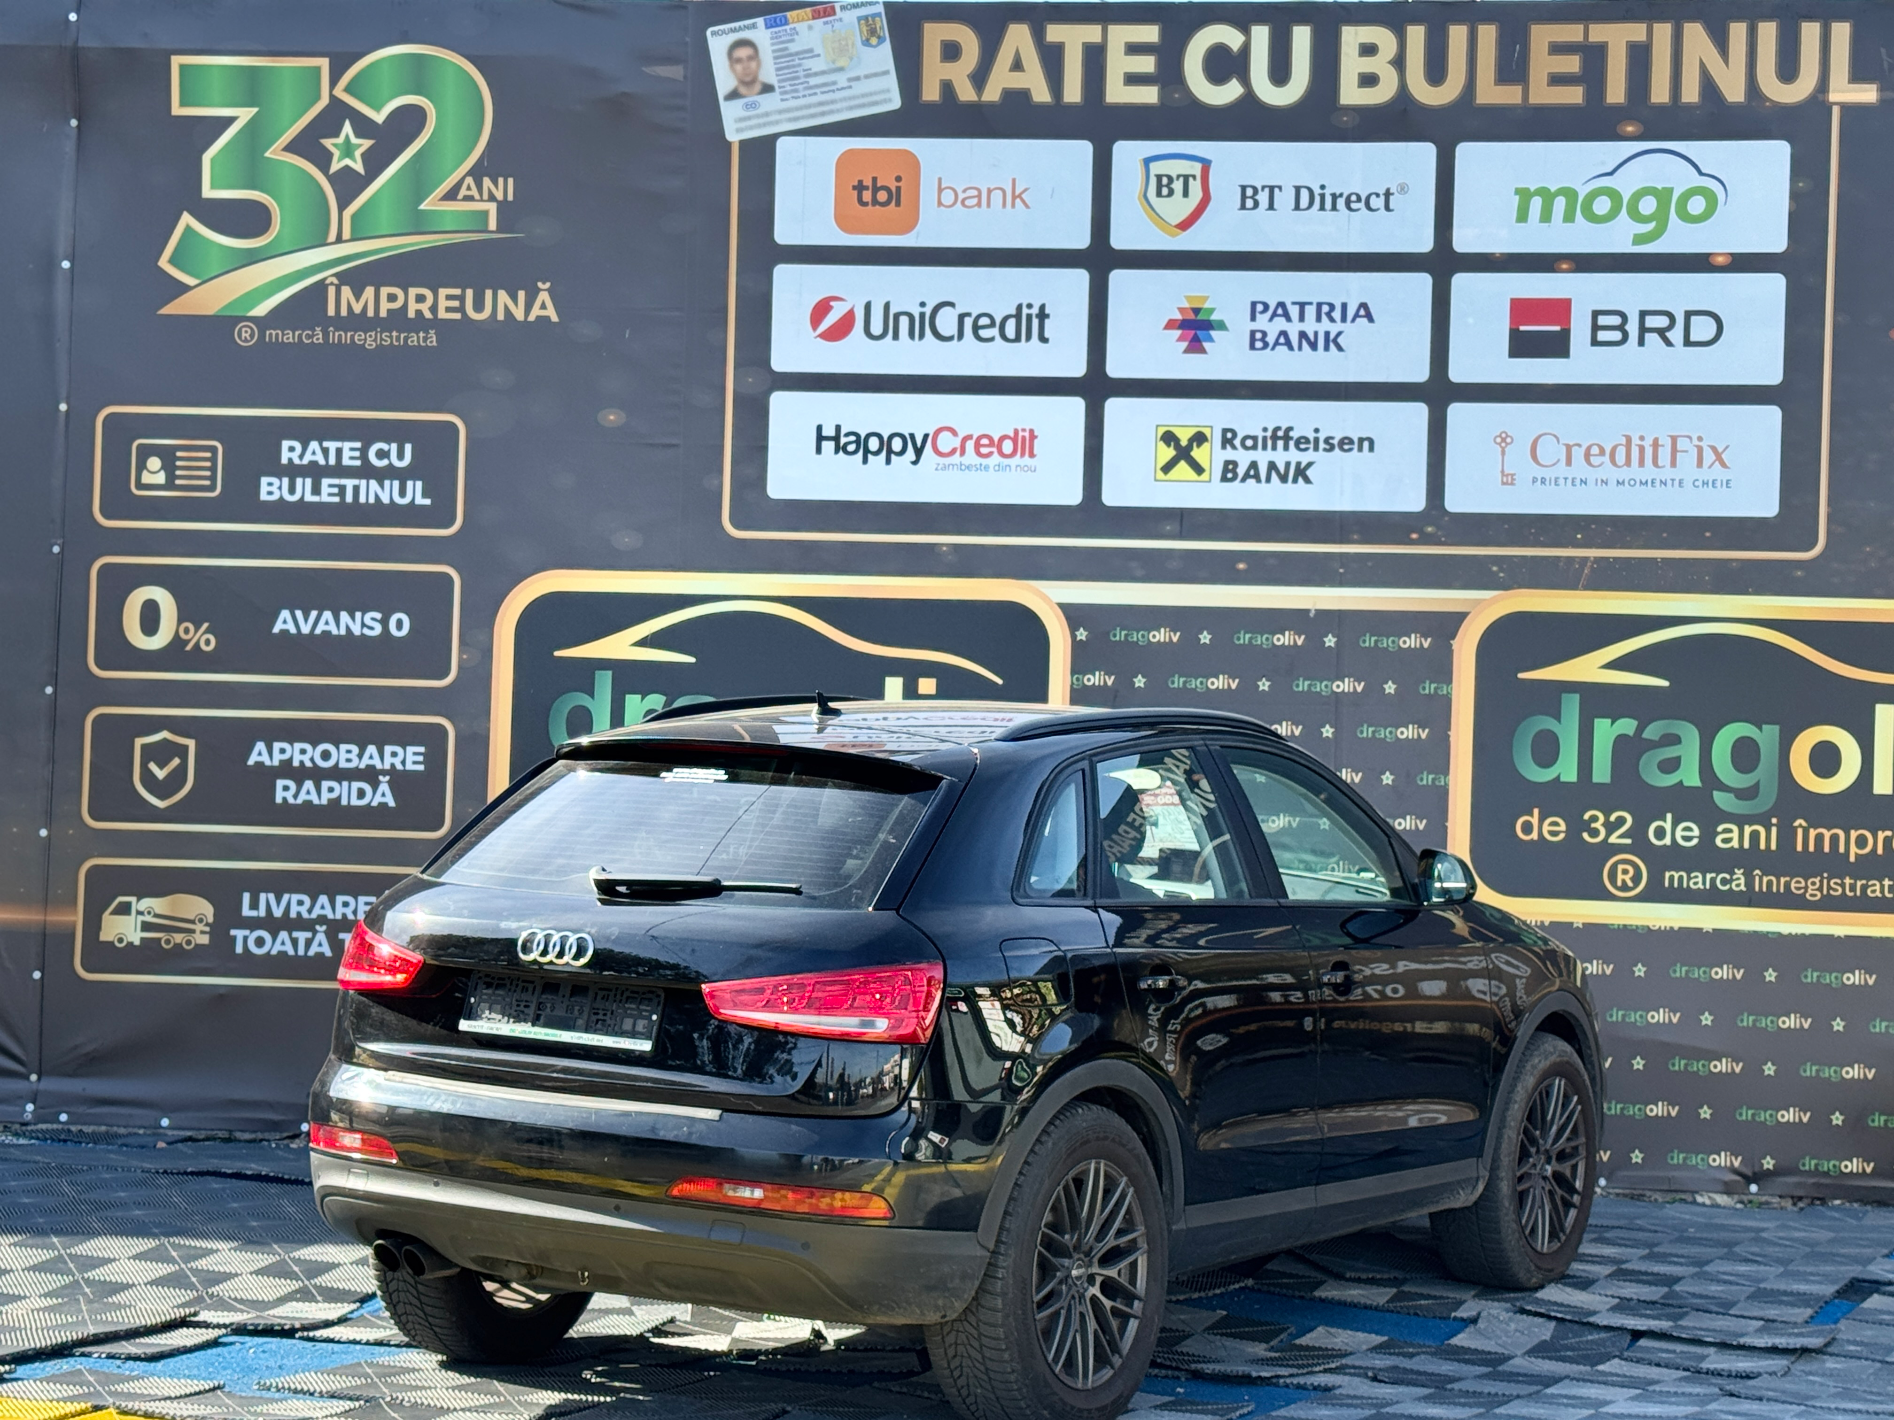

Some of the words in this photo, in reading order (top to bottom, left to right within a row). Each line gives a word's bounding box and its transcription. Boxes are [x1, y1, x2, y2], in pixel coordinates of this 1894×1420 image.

[711, 22, 758, 38] ROUMANIE
[921, 21, 1161, 105] RATE
[1183, 22, 1312, 107] CU
[1338, 20, 1879, 107] BULETINUL
[157, 44, 497, 287] 32
[457, 176, 514, 202] ANI
[851, 175, 903, 208] tbi
[936, 177, 1031, 209] bank
[1154, 174, 1197, 199] BT
[1238, 184, 1282, 211] BT
[1514, 185, 1719, 247] mogo
[324, 276, 560, 322] ÎMPREUNĂ
[863, 300, 1050, 344] UniCredit
[1249, 300, 1376, 324] PATRIA
[265, 327, 324, 344] marcă
[328, 327, 438, 349] înregistrată
[1590, 309, 1724, 347] BRD
[1249, 329, 1346, 352] BANK
[815, 424, 1039, 466] HappyCredit
[1220, 426, 1375, 453] Raiffeisen
[1529, 432, 1731, 470] CreditFix
[280, 440, 362, 467] RATE
[368, 442, 412, 467] CU
[934, 461, 990, 473] zambeste
[993, 461, 1011, 473] din
[1015, 464, 1037, 473] nou
[1219, 459, 1316, 485] BANK
[259, 477, 432, 506] BULETINUL
[1531, 476, 1588, 487] PRIETEN
[1595, 478, 1609, 487] IN
[1616, 477, 1685, 488] MOMENTE
[1692, 478, 1732, 489] CHEIE
[122, 585, 216, 652] 0%
[271, 609, 383, 637] AVANS
[388, 612, 411, 638] 0
[1109, 627, 1181, 645] dragoliv
[1233, 630, 1306, 648] dragoliv
[1359, 632, 1432, 651] dragoliv
[1072, 671, 1115, 688] goliv
[1168, 674, 1239, 692] dragoliv
[1292, 677, 1365, 696] dragoliv
[1270, 721, 1303, 737] oliv
[1357, 723, 1429, 742] dragoliv
[246, 741, 426, 771] APROBARE
[1512, 693, 1894, 815] dragol
[275, 775, 396, 807] RAPIDĂ
[1394, 815, 1427, 831] oliv
[1515, 807, 1567, 842] de
[1582, 810, 1633, 844] 32
[1648, 813, 1700, 848] de
[1715, 817, 1778, 851] ani
[1792, 818, 1894, 863] împr
[1664, 868, 1746, 892] marcă
[1752, 869, 1894, 901] înregistrat
[242, 892, 377, 920] LIVRARE
[229, 924, 333, 957] TOATĂ
[1582, 959, 1615, 976] oliv
[1669, 962, 1745, 982] dragoliv
[1801, 968, 1877, 988] dragoliv
[1606, 1007, 1681, 1027] dragoliv
[1737, 1012, 1812, 1032] dragoliv
[1668, 1056, 1744, 1076] dragoliv
[1800, 1062, 1877, 1082] dragoliv
[1604, 1100, 1680, 1119] dragoliv
[1735, 1105, 1811, 1125] dragoliv
[1667, 1149, 1743, 1169] dragoliv
[1798, 1156, 1875, 1176] dragoliv
